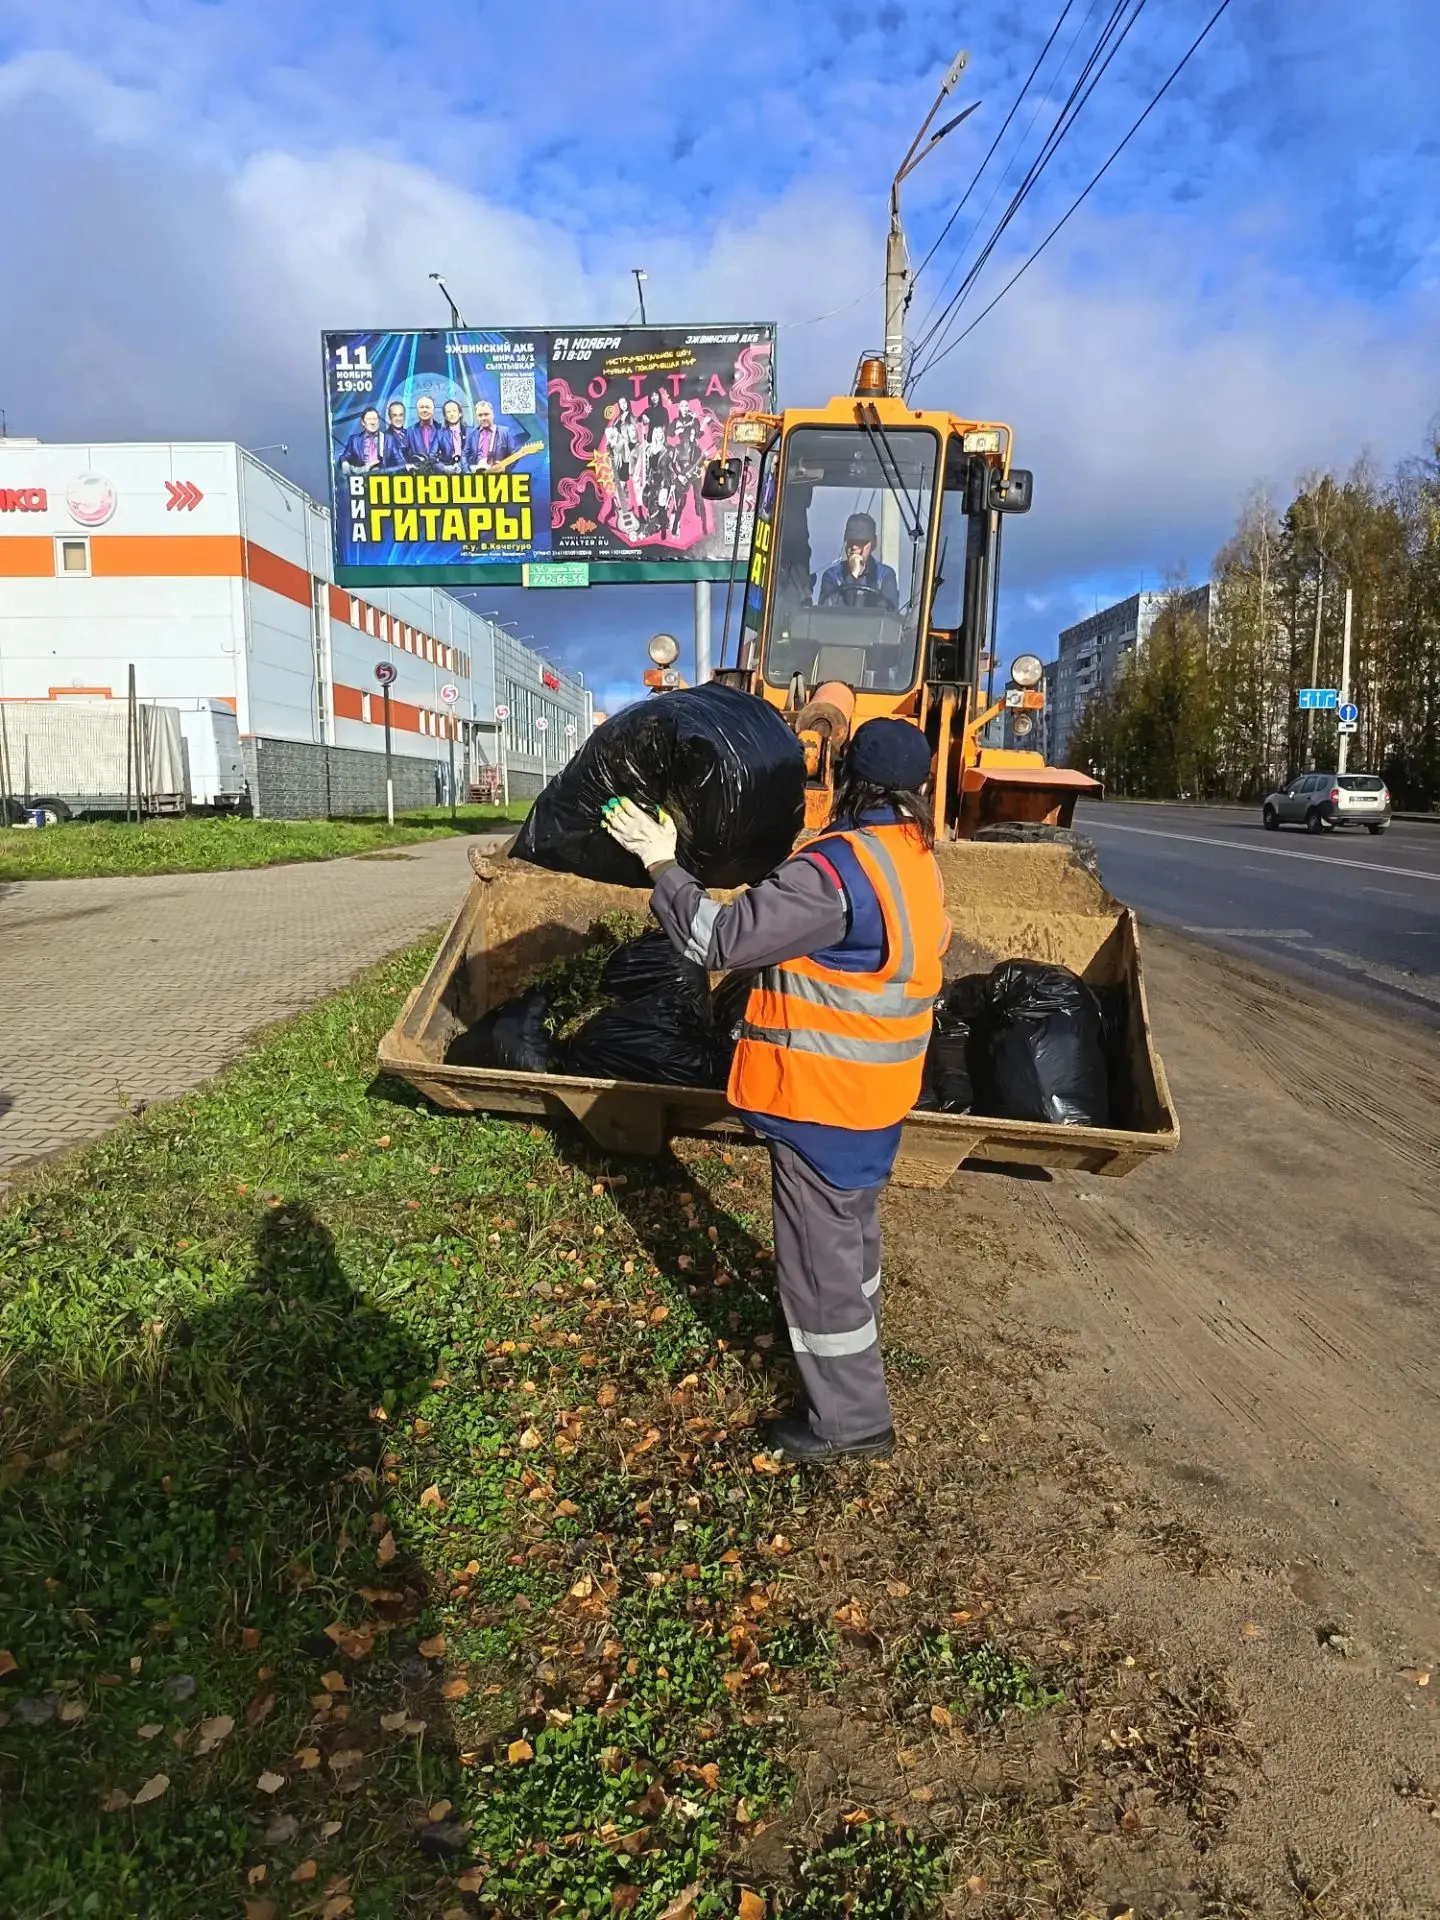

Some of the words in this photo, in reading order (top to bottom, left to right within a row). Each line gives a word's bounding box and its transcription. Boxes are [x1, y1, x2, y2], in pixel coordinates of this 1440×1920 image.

[553, 338, 570, 350] 24
[571, 337, 622, 350] НОЯБРЯ
[685, 333, 740, 344] ЭЖВИНСКИЙ
[740, 333, 760, 343] ДКБ
[445, 341, 512, 354] ЭЖВИНСКИЙ
[513, 343, 535, 354] ДКБ
[335, 345, 372, 370] 11
[492, 354, 515, 362] МИРА
[516, 354, 536, 362] 10/1
[485, 362, 536, 370] СЫКТЫВКАР
[336, 371, 372, 379] НОЯБРЯ
[336, 380, 372, 392] 19:00
[368, 473, 531, 505] ПОЮЩИЕ
[369, 507, 532, 543] ГИТАРЫ
